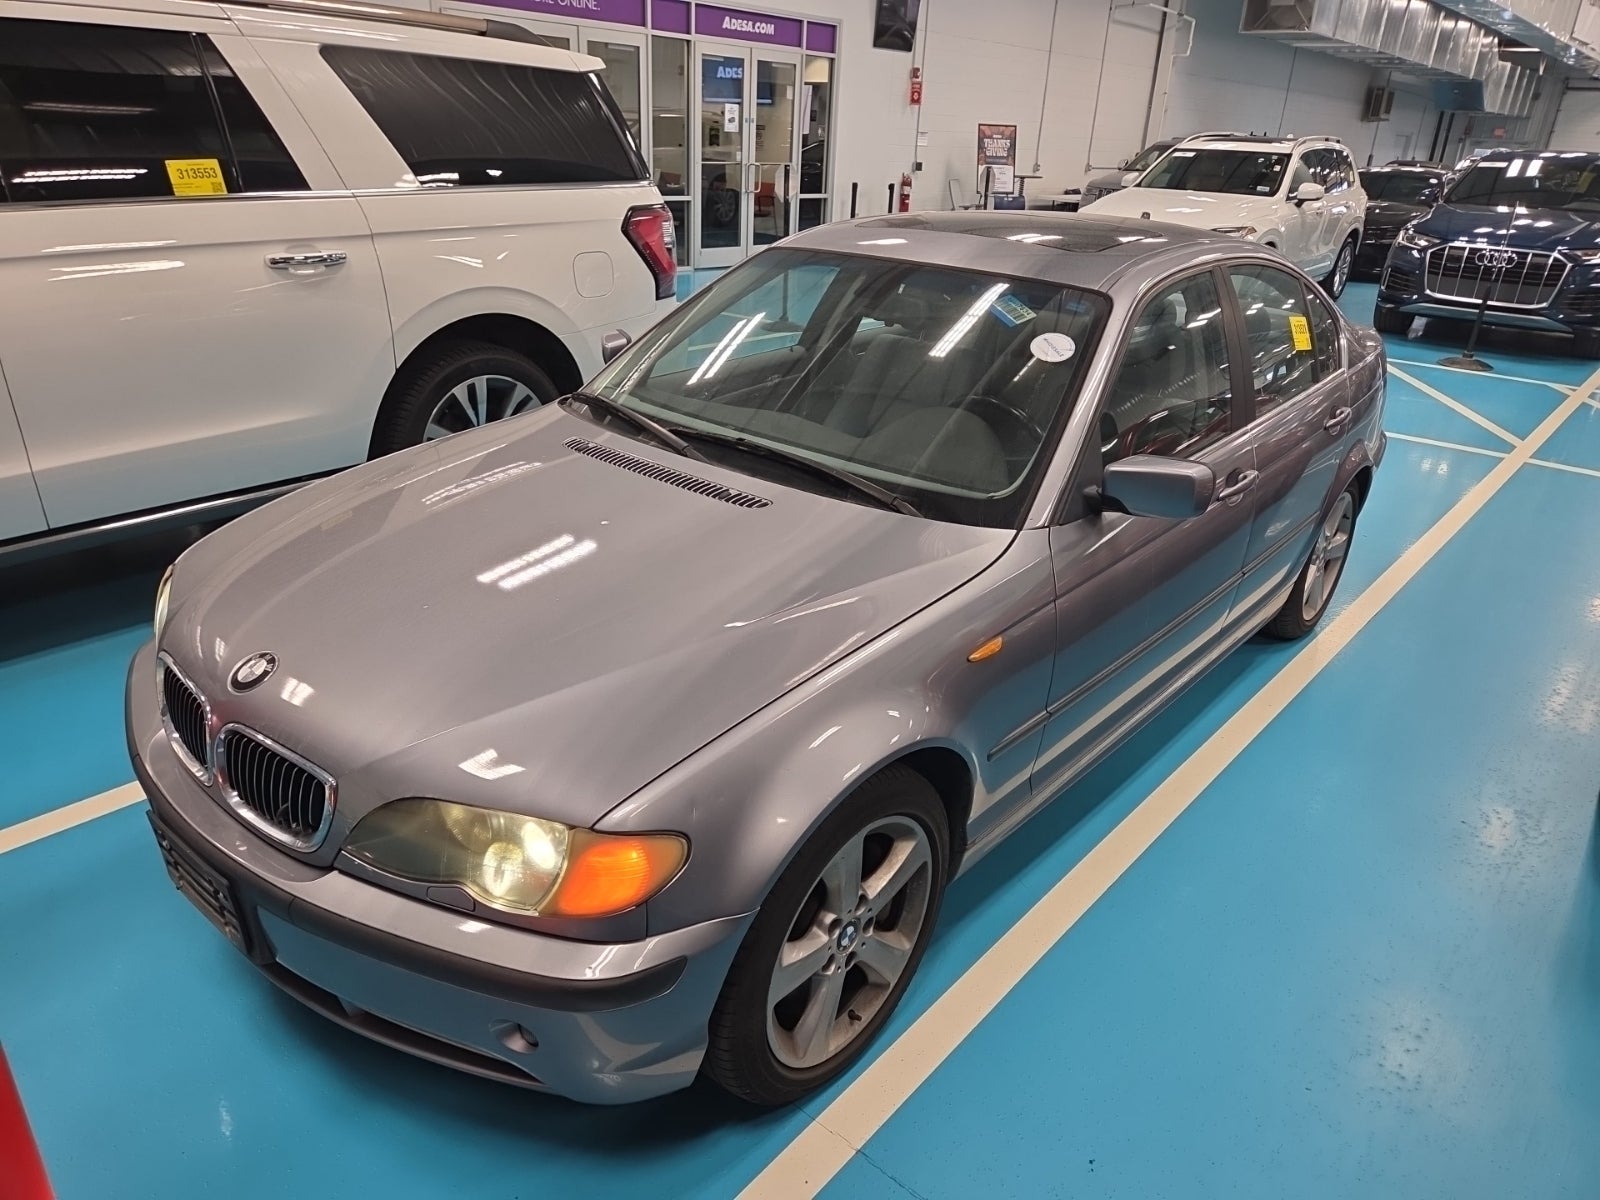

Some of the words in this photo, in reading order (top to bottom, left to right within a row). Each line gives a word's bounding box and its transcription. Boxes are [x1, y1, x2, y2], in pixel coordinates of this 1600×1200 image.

[722, 16, 774, 35] ADESA.COM
[716, 66, 743, 79] ADES
[983, 138, 1011, 148] THANKS
[177, 167, 217, 179] 313553
